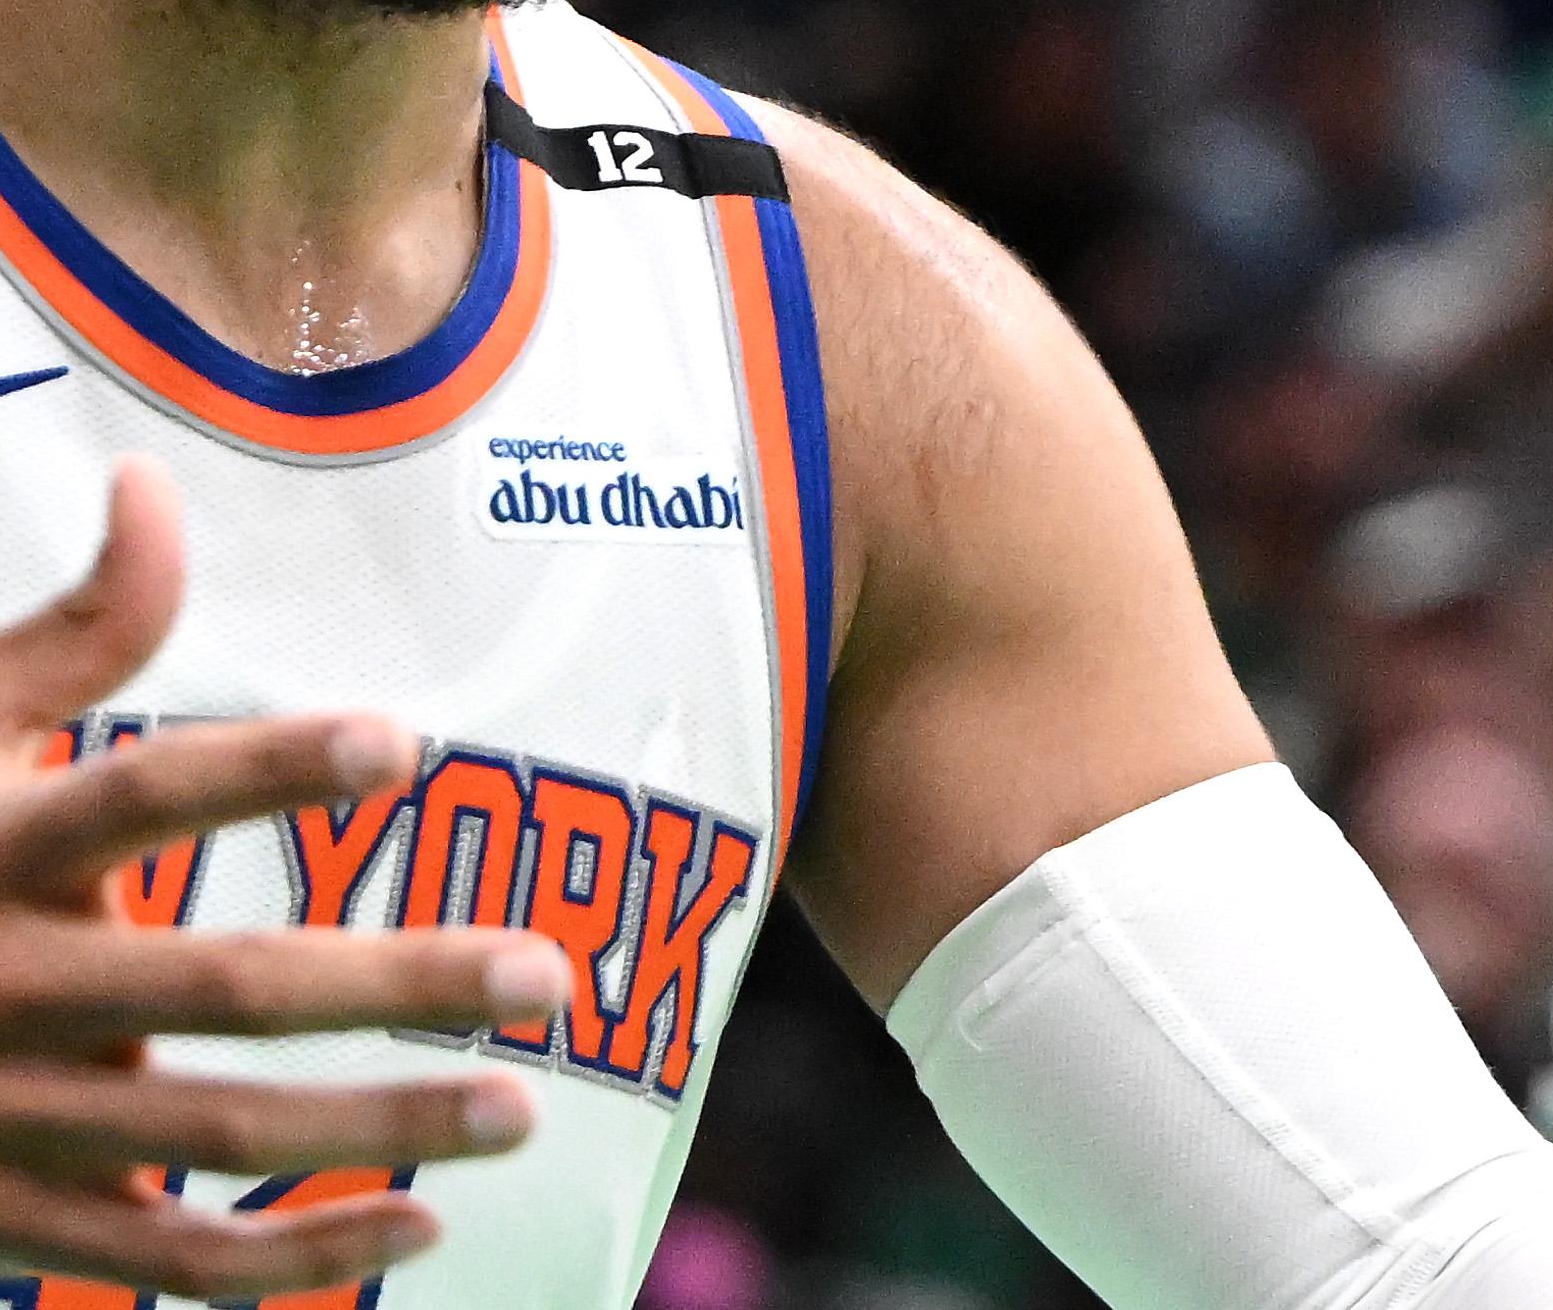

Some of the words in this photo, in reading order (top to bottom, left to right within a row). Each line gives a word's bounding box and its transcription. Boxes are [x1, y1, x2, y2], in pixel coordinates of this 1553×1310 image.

[586, 130, 664, 183] 12
[488, 435, 628, 465] experience
[489, 469, 593, 525] abu
[600, 471, 745, 531] dhabi
